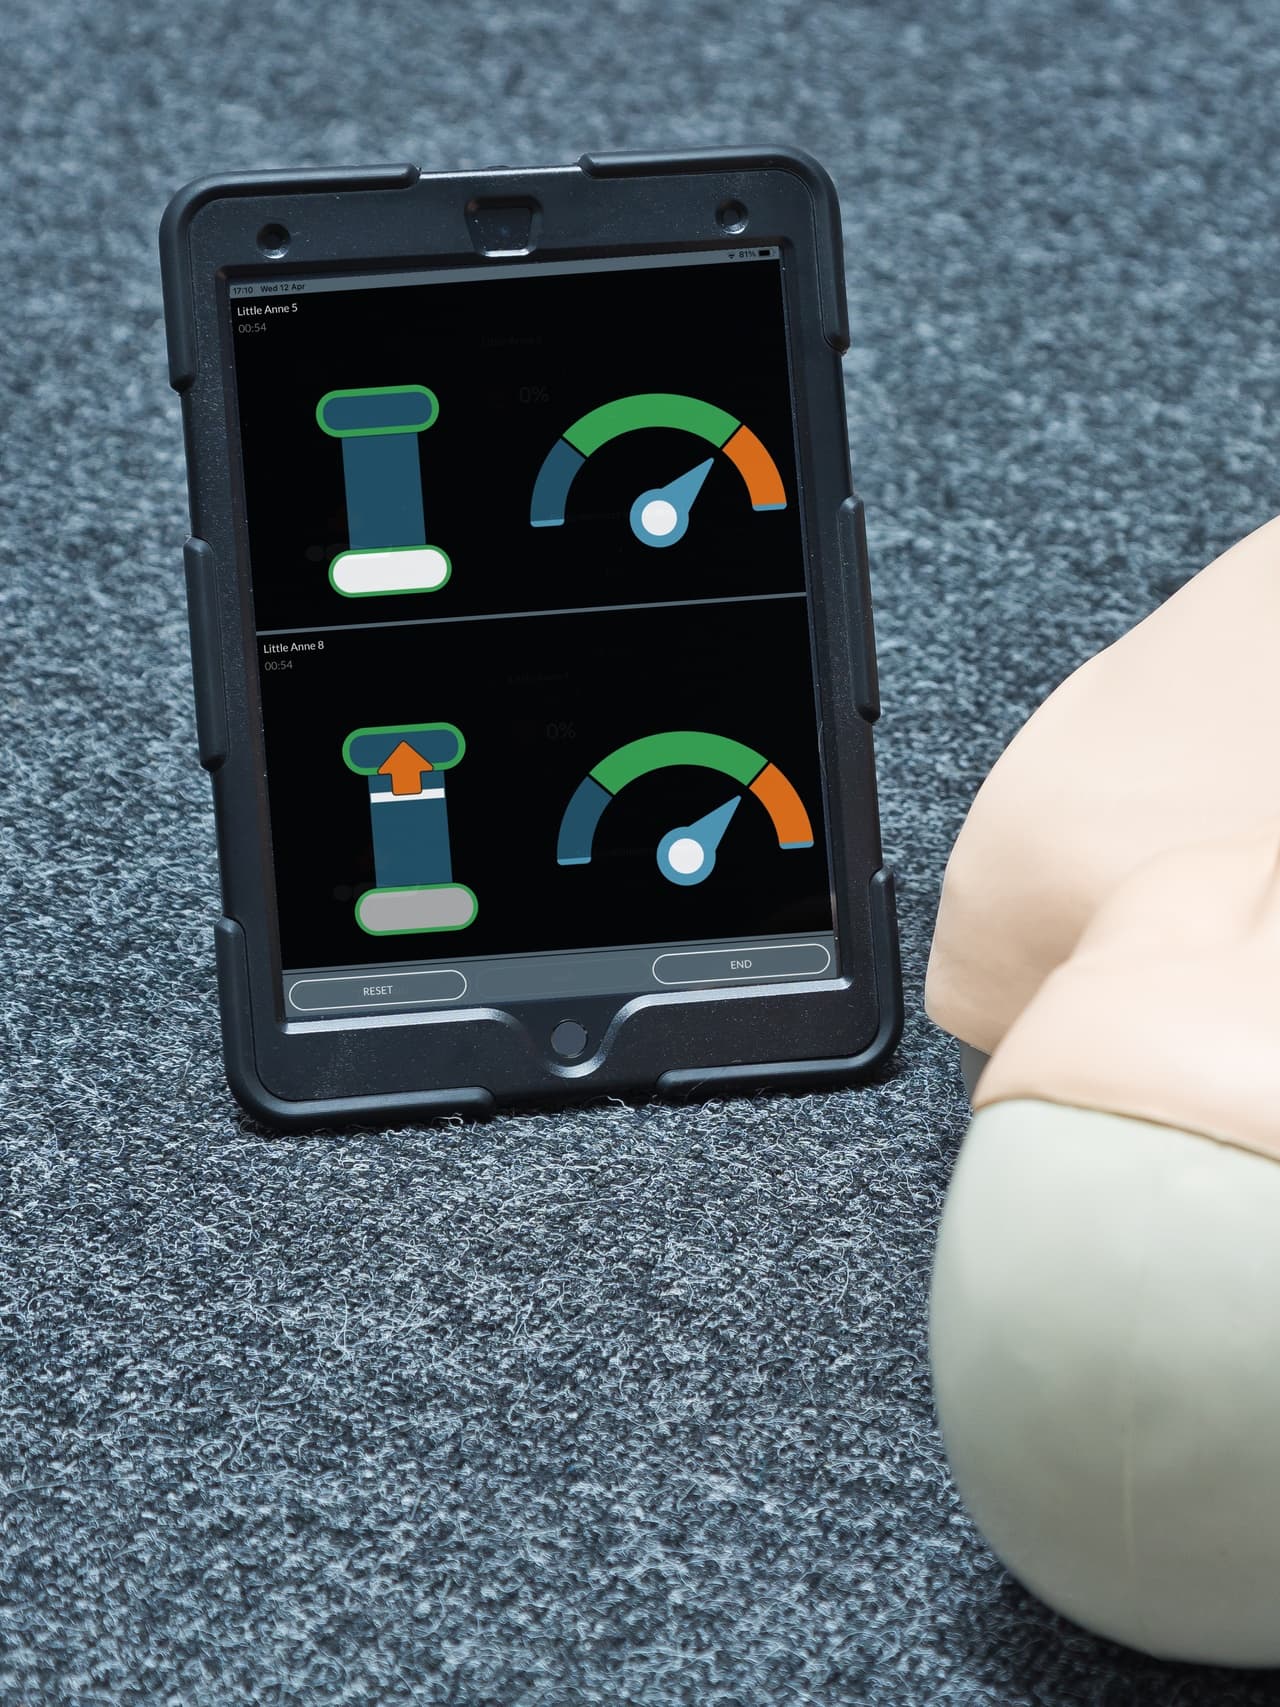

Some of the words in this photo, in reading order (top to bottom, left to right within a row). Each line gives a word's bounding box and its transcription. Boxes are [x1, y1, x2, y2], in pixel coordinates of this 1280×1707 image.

[232, 286, 254, 295] 17:10
[260, 284, 278, 292] Wed
[280, 283, 289, 291] 12
[291, 283, 305, 291] Apr
[237, 305, 263, 317] Little
[264, 304, 290, 315] Anne
[291, 302, 298, 313] 5
[238, 322, 267, 334] 00:54
[263, 642, 289, 654] Little
[290, 642, 316, 652] Anne
[317, 640, 325, 650] 8
[264, 660, 293, 671] 00:54
[730, 959, 753, 970] END
[363, 985, 393, 997] RESET
